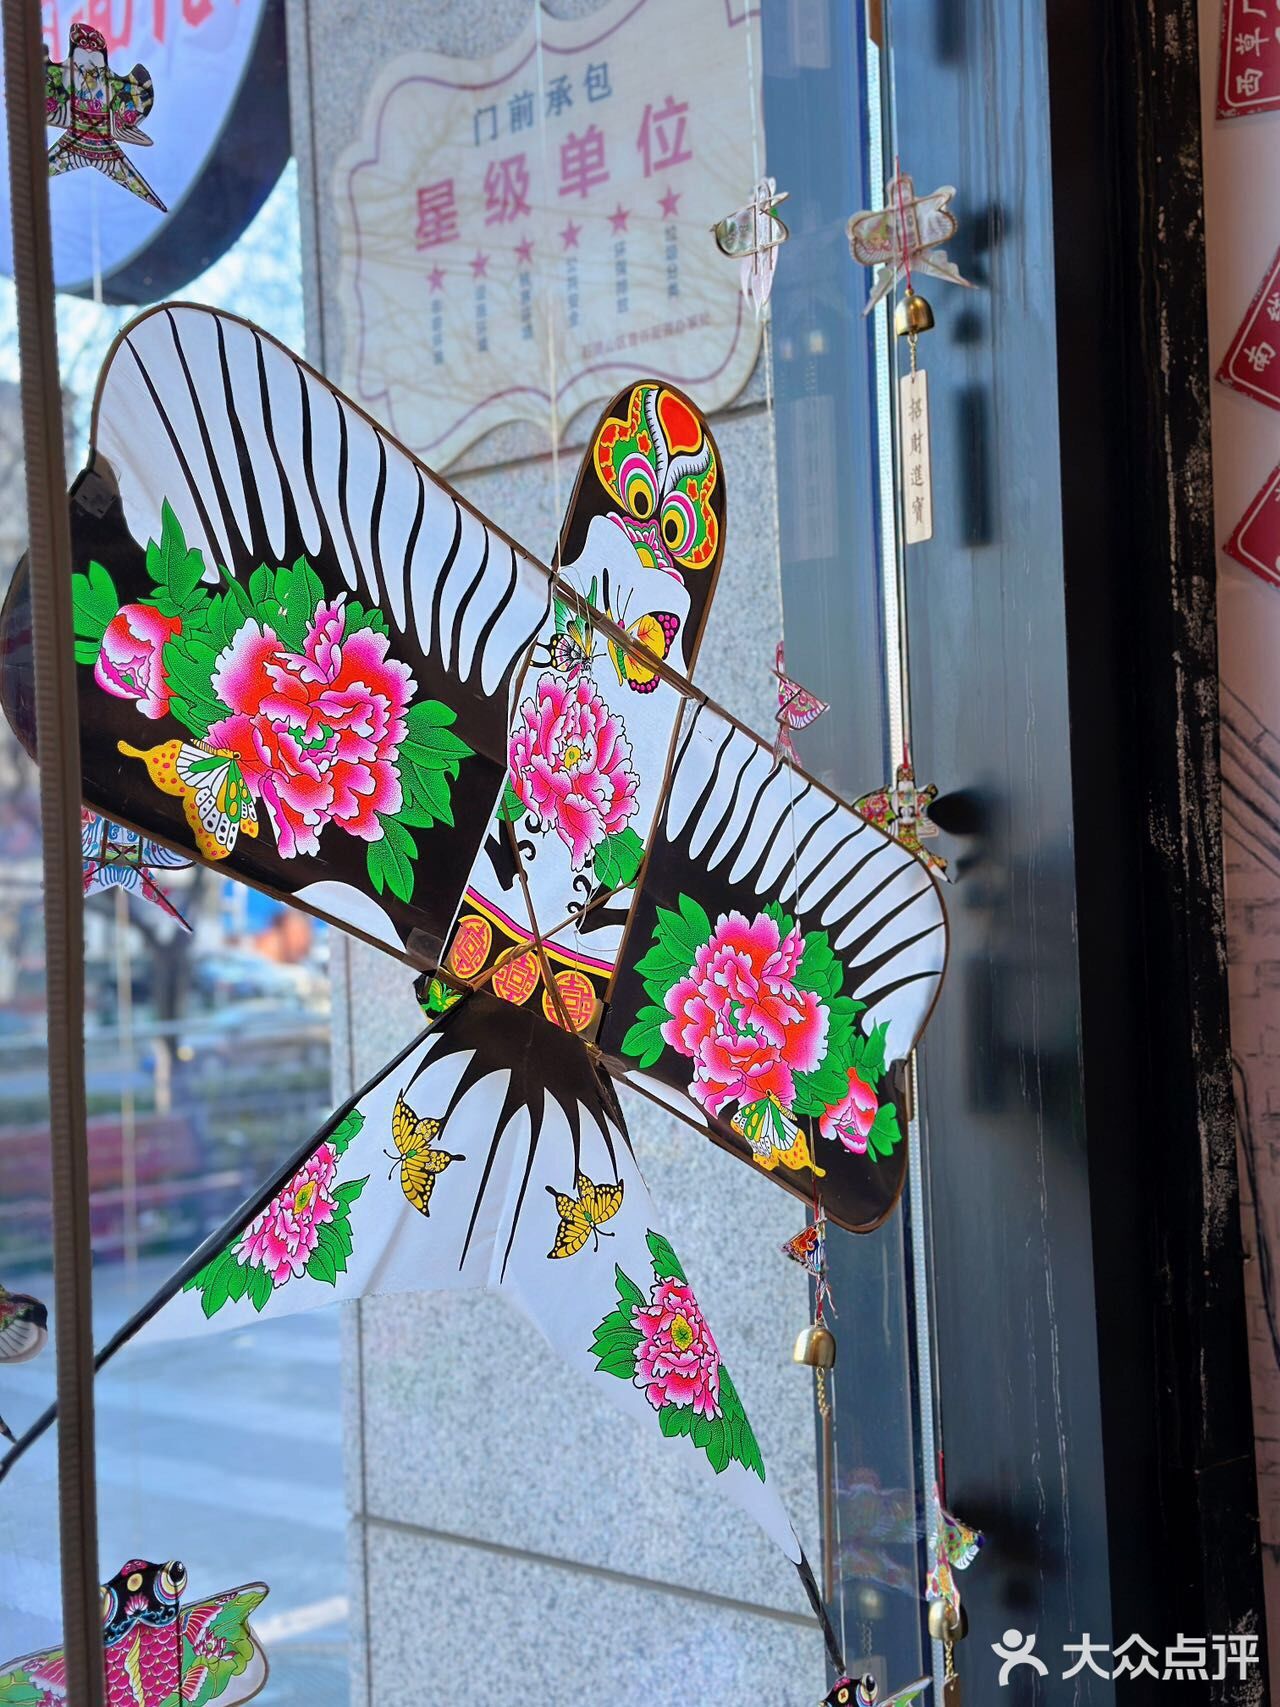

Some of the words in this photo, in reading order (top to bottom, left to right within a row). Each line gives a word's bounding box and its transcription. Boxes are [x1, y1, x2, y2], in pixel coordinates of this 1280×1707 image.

[474, 62, 613, 147] 门前承包
[416, 95, 693, 252] 星级单位
